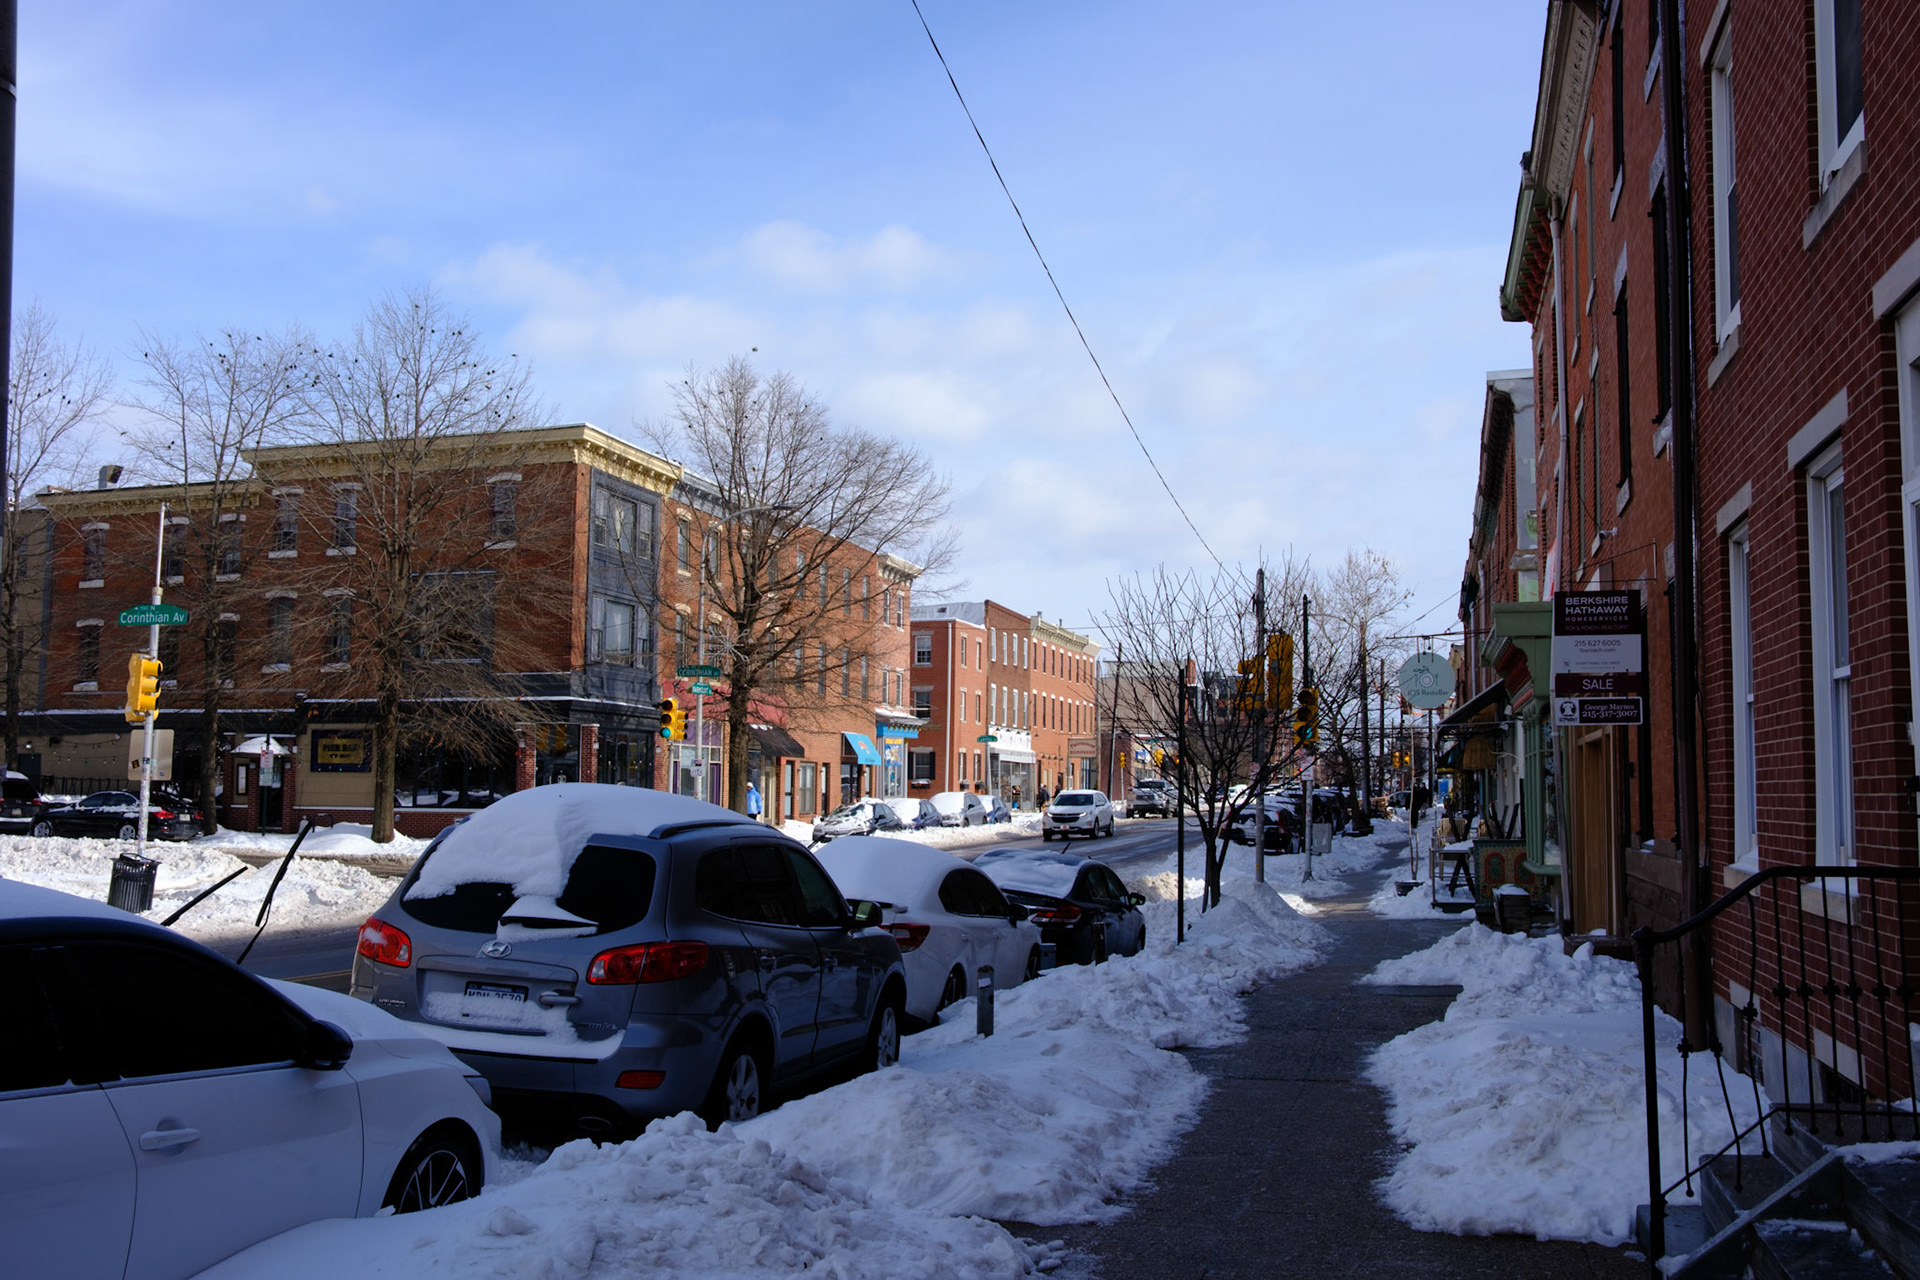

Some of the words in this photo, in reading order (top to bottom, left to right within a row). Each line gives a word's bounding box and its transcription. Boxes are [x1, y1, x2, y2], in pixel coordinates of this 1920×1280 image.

[1565, 596, 1628, 605] BERKSHIRE
[1565, 606, 1628, 614] HATHAWAY
[120, 612, 169, 623] Corinthian
[173, 612, 185, 622] Av
[678, 668, 712, 677] CORINTHIAN
[1582, 679, 1614, 690] SALE
[1584, 704, 1608, 712] George
[1609, 703, 1635, 711] Maynes
[1582, 710, 1638, 719] 215-317-3007
